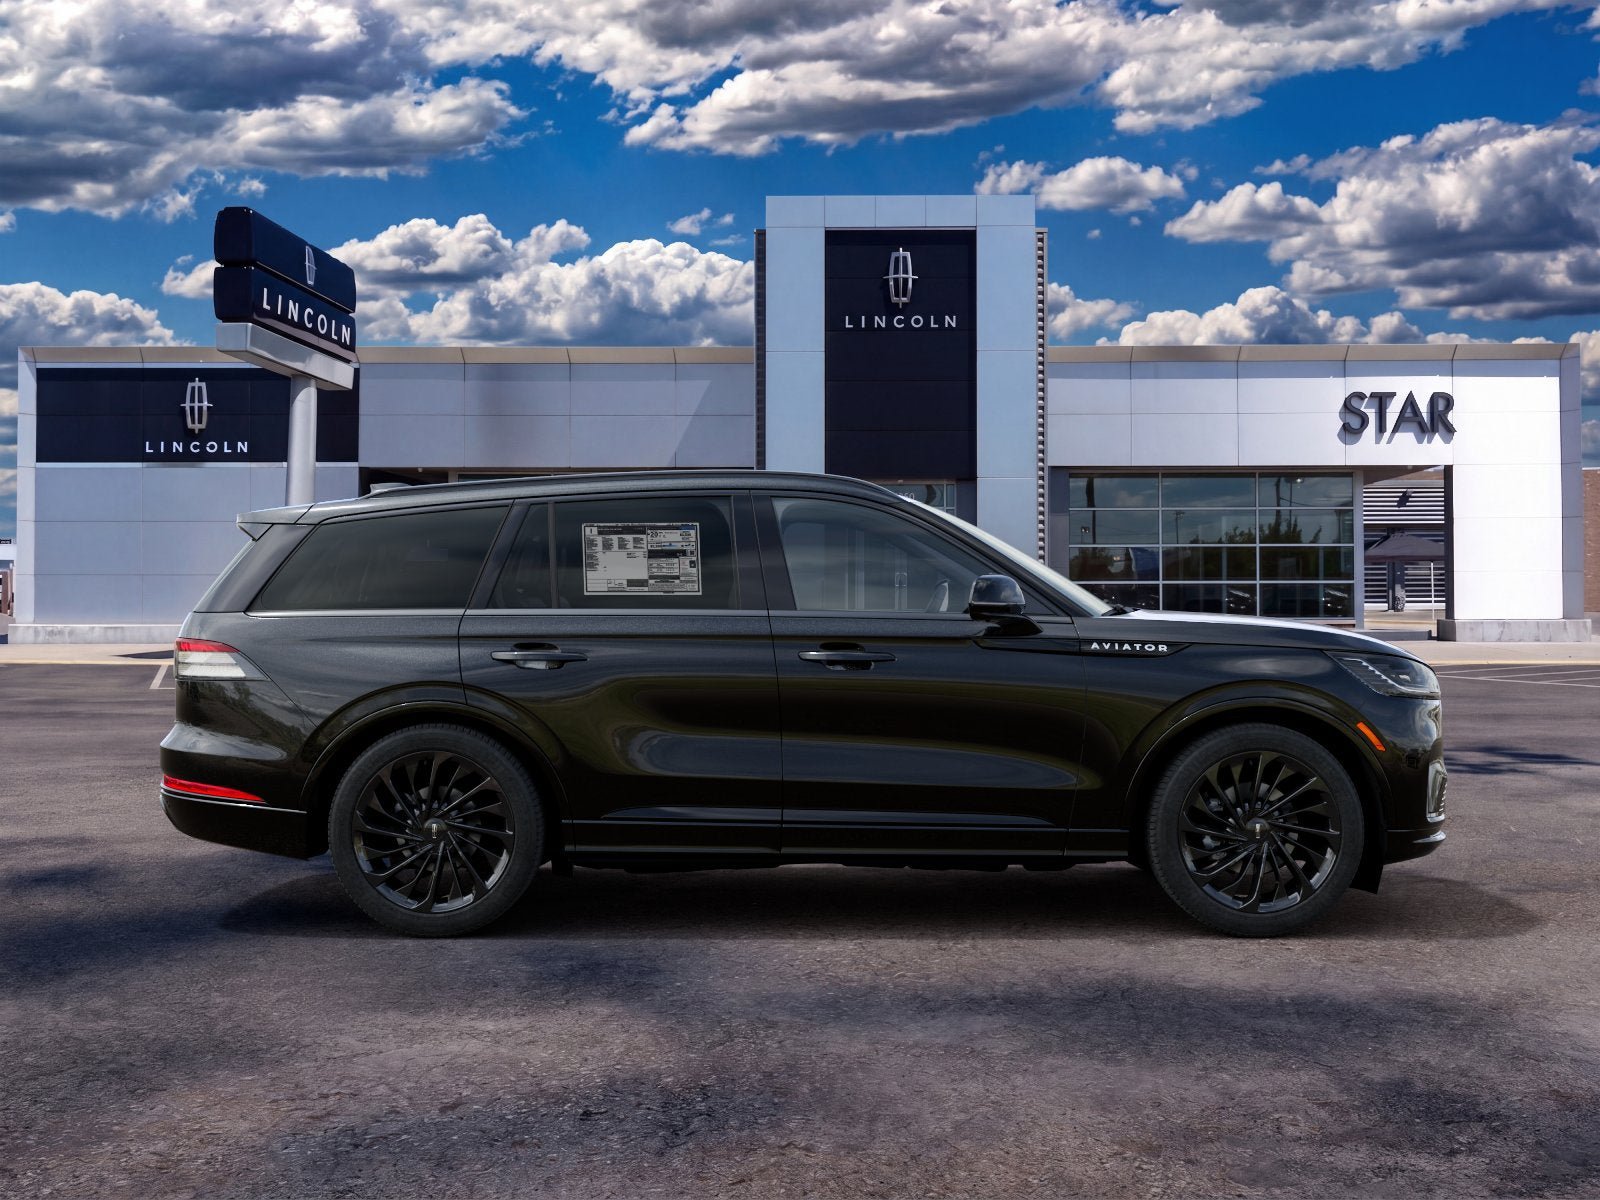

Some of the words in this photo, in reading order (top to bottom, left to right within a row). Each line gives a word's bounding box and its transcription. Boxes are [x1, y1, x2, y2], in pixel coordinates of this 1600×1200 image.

[262, 287, 351, 346] LINCOLN
[845, 315, 957, 328] LINCOLN
[1342, 391, 1457, 435] STAR
[145, 441, 248, 453] LINCOLN
[1090, 642, 1168, 652] AVIATOR
